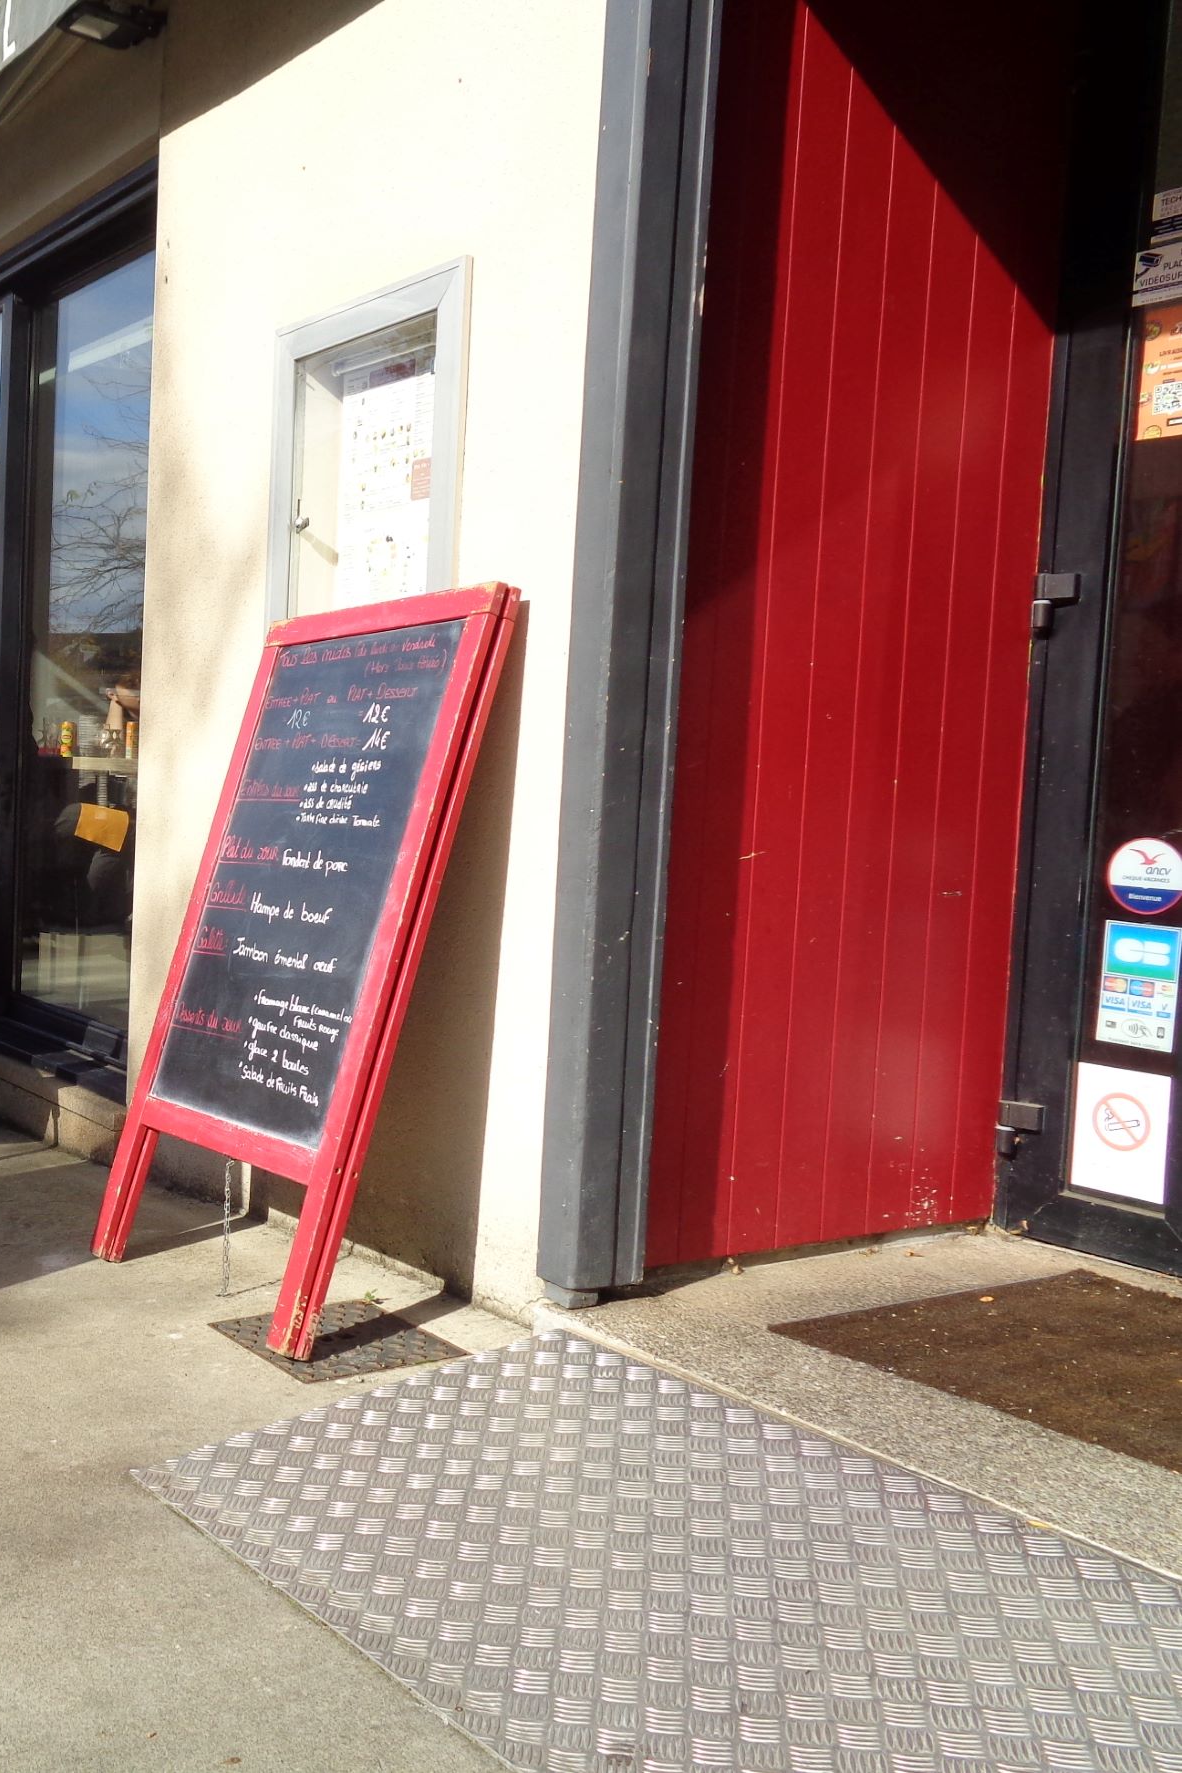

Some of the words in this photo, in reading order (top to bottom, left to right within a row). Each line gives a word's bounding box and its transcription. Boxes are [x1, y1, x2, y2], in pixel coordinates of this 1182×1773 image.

[287, 708, 311, 729] 12€
[362, 702, 390, 723] 12€
[362, 727, 391, 751] 14€
[315, 796, 325, 810] de
[352, 815, 380, 828] Tomate
[313, 850, 324, 870] de
[325, 861, 348, 878] porc
[1145, 866, 1172, 876] ancv
[250, 892, 280, 924] Hampe
[283, 900, 294, 919] de
[233, 937, 268, 963] Jambon
[1105, 996, 1125, 1005] VISA
[1131, 1000, 1152, 1009] VISA
[279, 1024, 319, 1053] classique
[248, 1040, 268, 1061] glace
[271, 1049, 279, 1062] 2
[282, 1049, 309, 1075] boules
[241, 1065, 264, 1083] Salade
[266, 1072, 275, 1088] de
